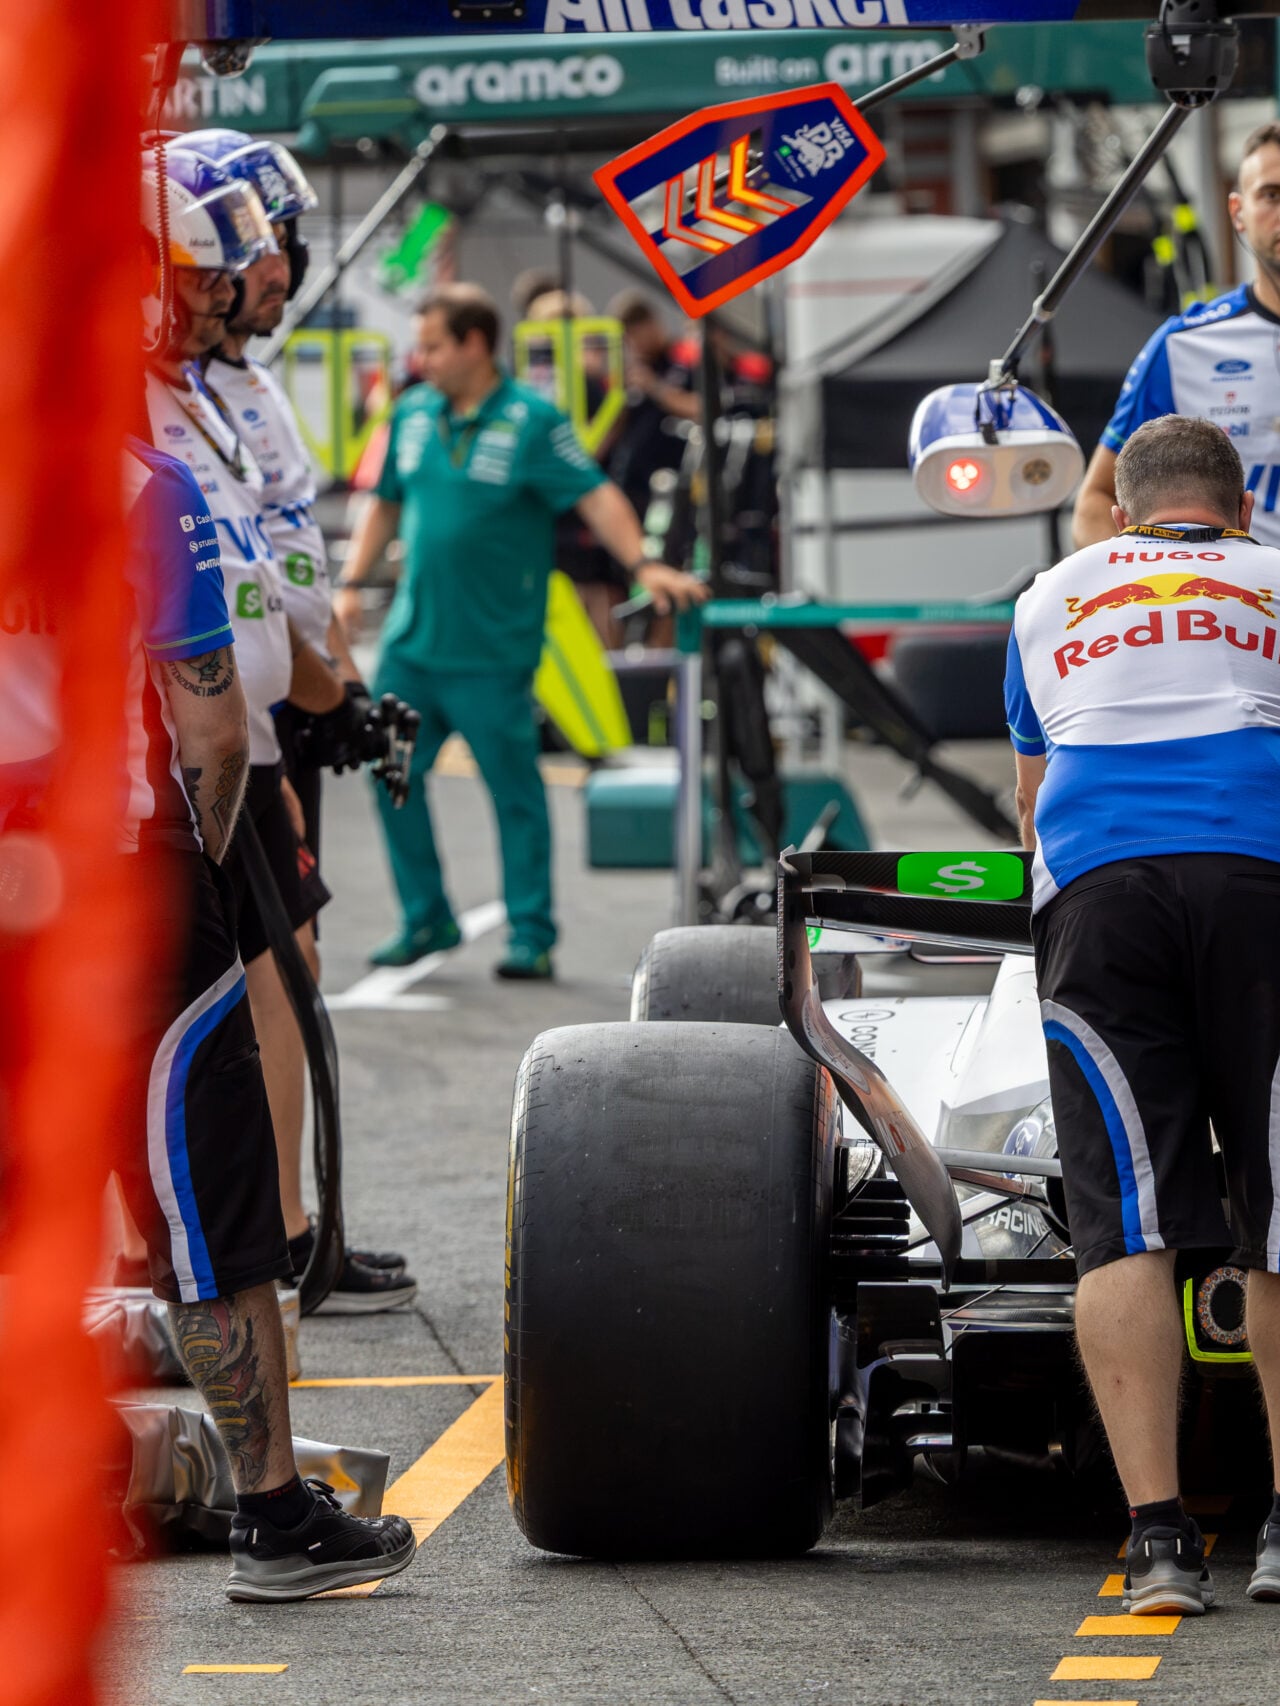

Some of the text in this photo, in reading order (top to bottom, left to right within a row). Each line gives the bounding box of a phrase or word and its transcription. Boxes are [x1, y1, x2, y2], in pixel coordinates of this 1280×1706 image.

[413, 54, 624, 106] aramco
[714, 40, 946, 85] Built on arm
[164, 74, 266, 118] RTIN
[830, 116, 855, 149] VISA
[1183, 302, 1232, 326] HUGO
[1108, 551, 1226, 564] HUGO
[1052, 610, 1164, 680] Red
